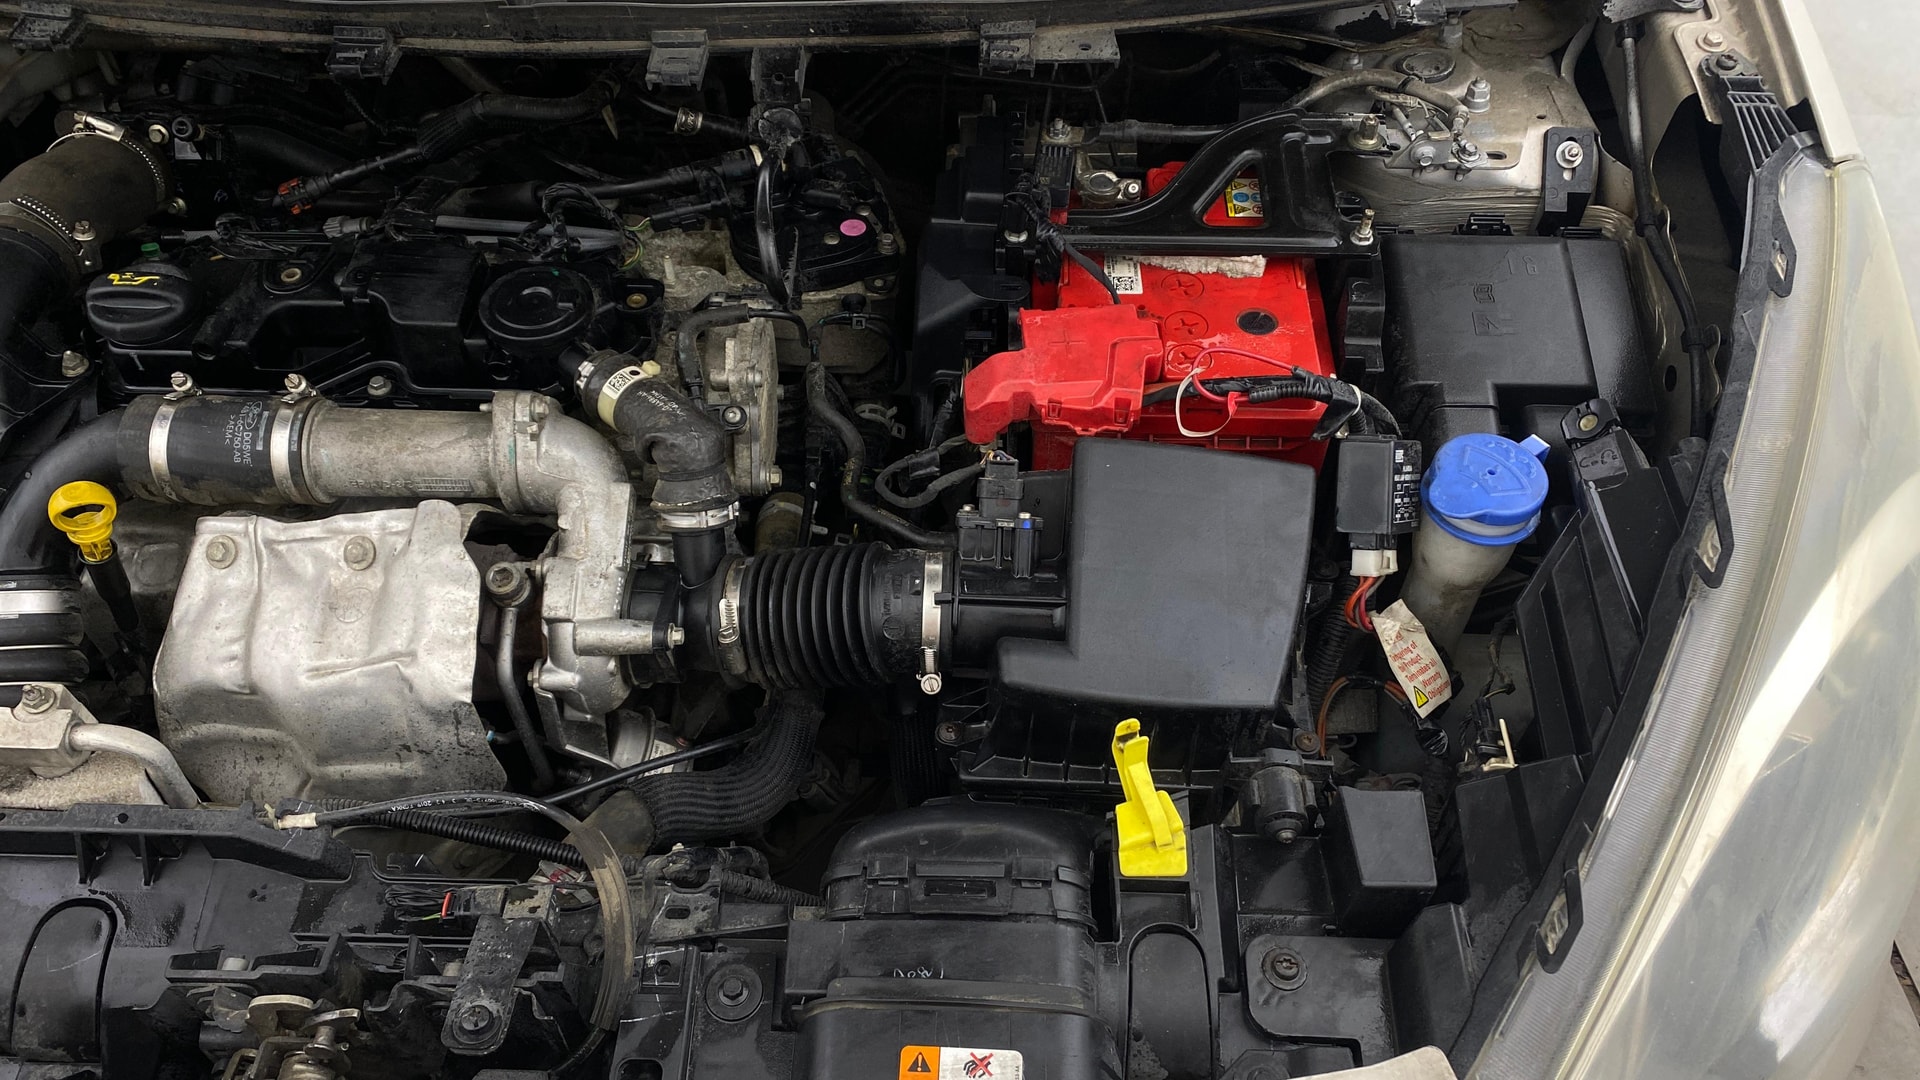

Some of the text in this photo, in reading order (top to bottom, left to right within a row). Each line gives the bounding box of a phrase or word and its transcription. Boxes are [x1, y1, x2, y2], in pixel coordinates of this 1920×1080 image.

[1405, 654, 1423, 670] Product
[1405, 664, 1431, 682] Terminates
[1421, 671, 1442, 688] Warranty
